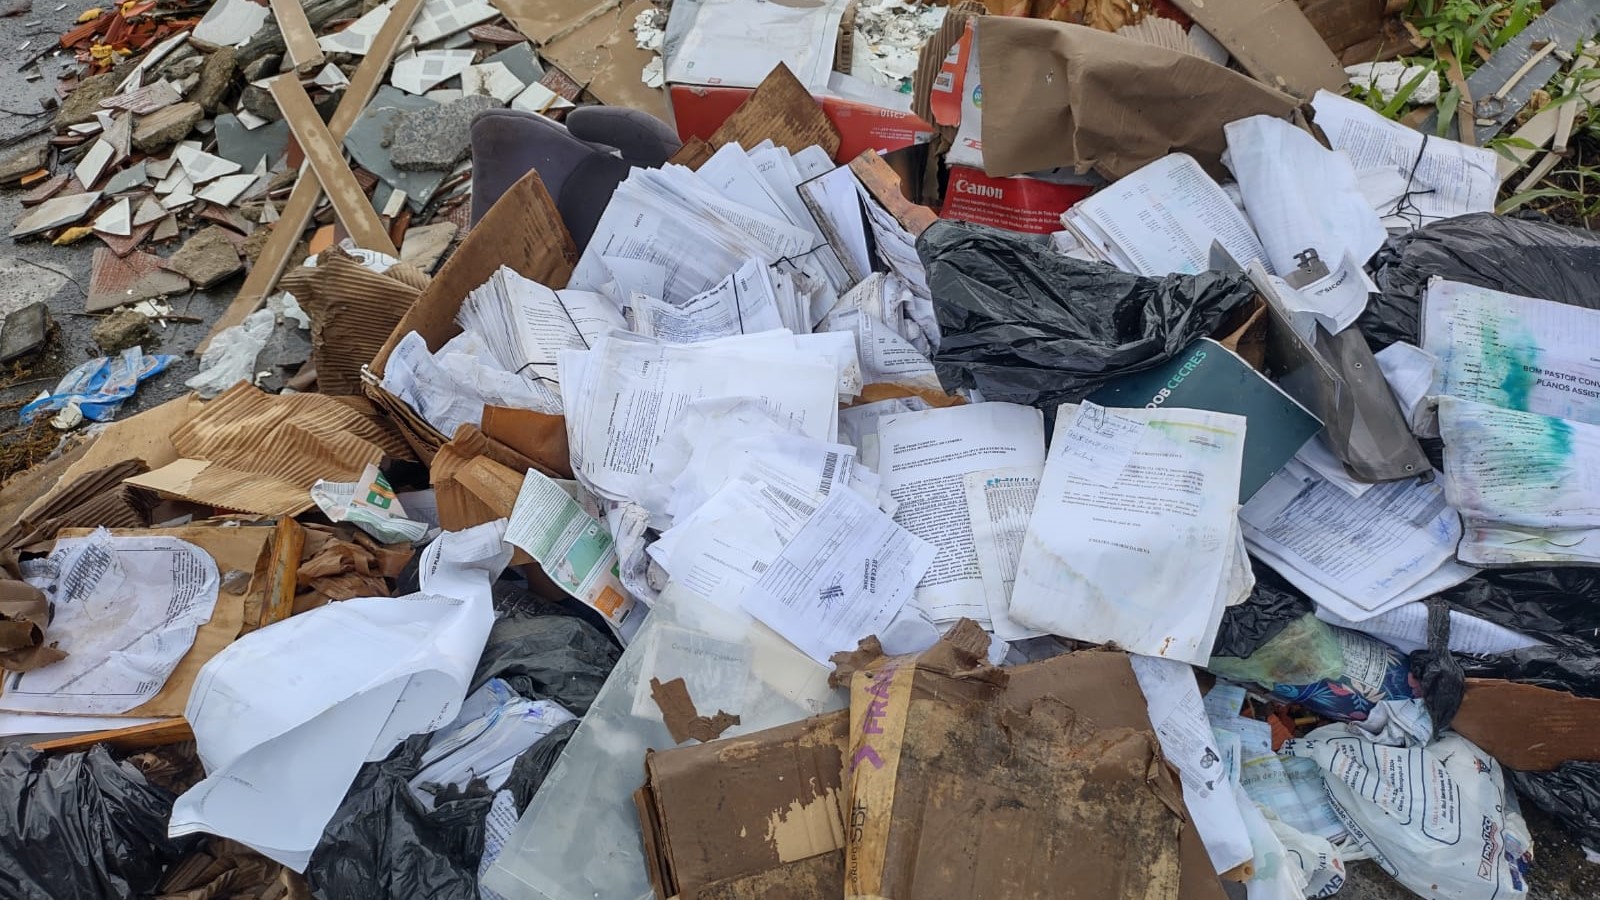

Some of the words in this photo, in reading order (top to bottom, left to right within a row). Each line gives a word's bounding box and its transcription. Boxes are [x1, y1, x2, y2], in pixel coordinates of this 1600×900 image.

[955, 179, 1004, 200] Canon
[1167, 350, 1207, 389] CECRES
[1523, 365, 1542, 375] BOM
[1544, 369, 1577, 382] PASTOR
[1536, 378, 1570, 392] PLANOS
